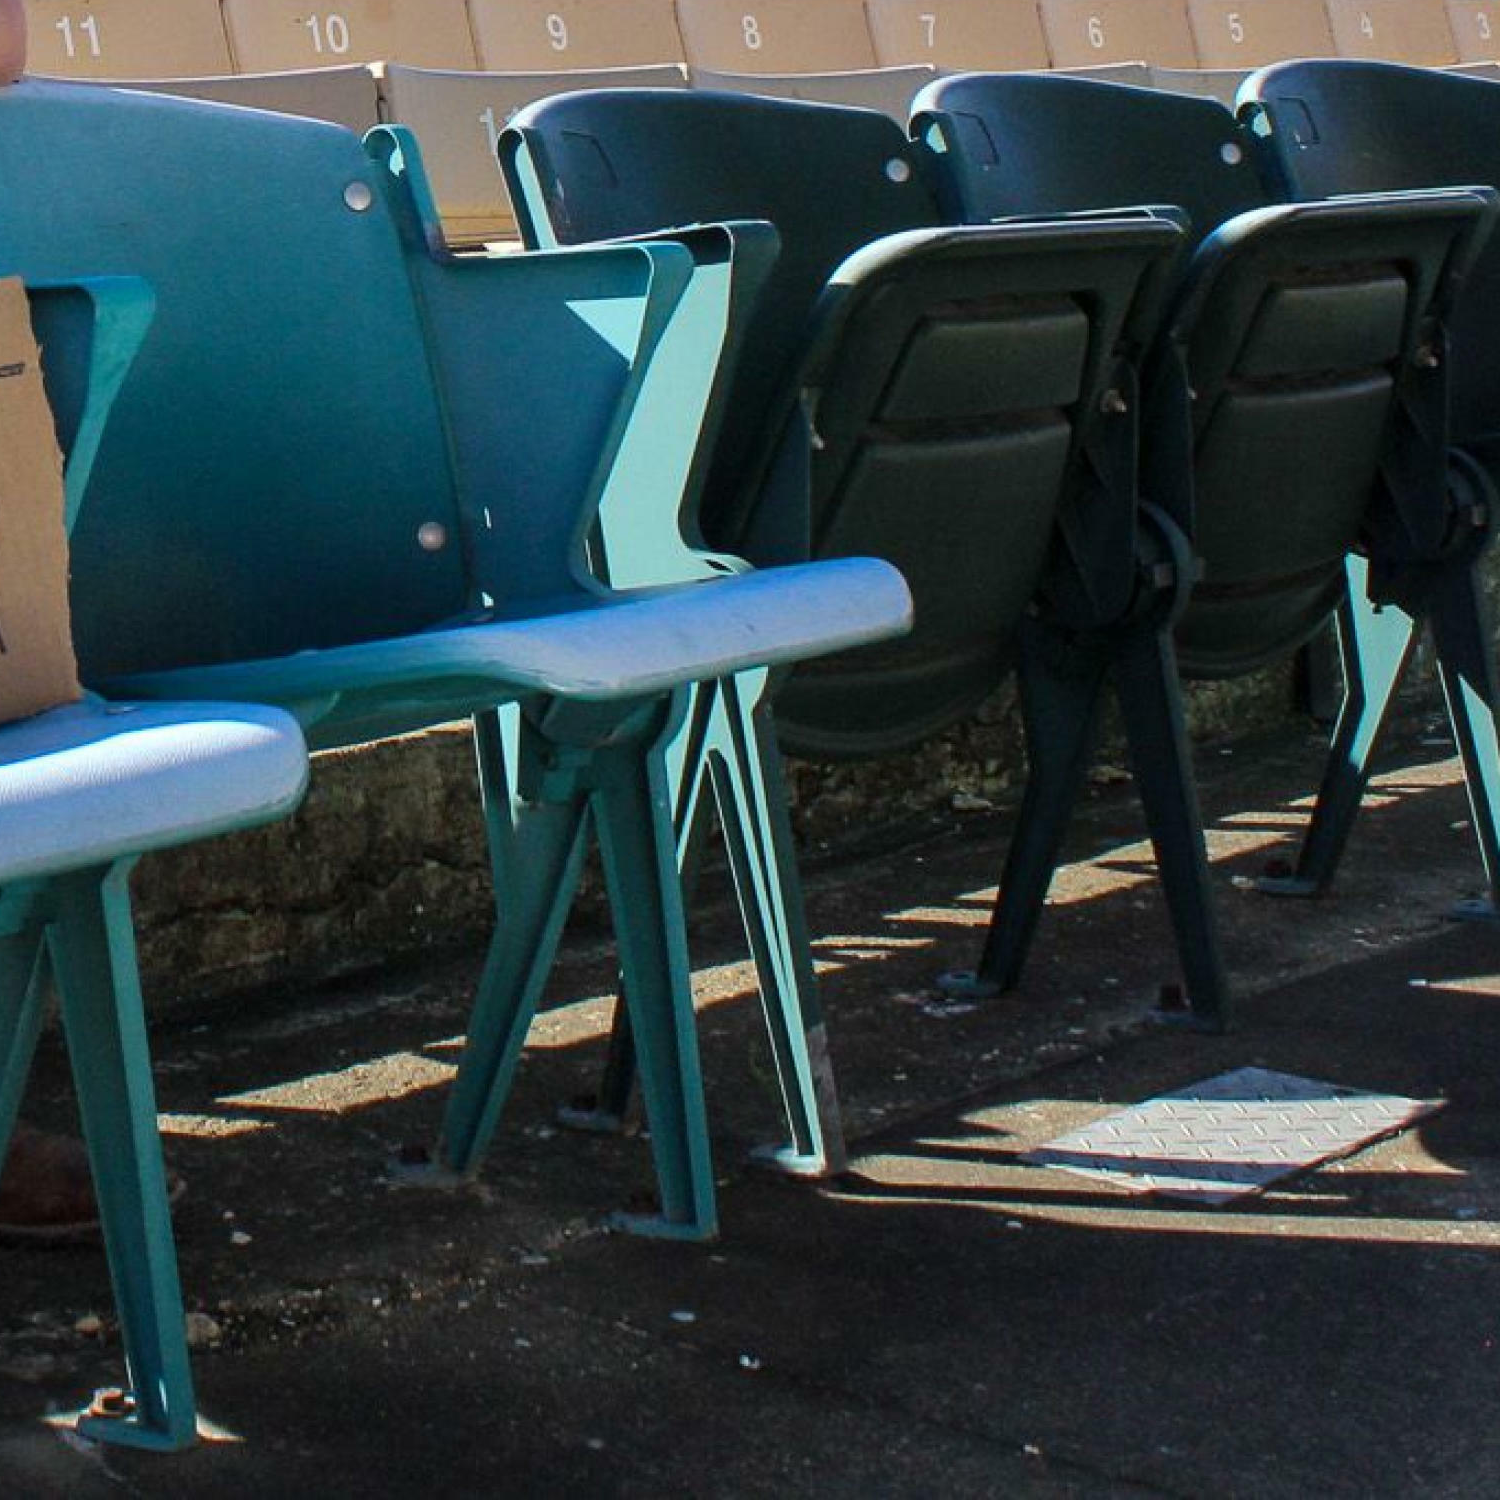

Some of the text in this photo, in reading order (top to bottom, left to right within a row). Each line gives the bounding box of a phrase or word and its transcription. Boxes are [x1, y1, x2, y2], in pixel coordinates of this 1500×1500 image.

[54, 13, 102, 58] 11
[305, 13, 350, 55] 10
[545, 12, 570, 52] 9
[741, 12, 762, 51] 8
[917, 12, 937, 49] 7
[1086, 15, 1105, 49] 6
[1227, 12, 1245, 45] 5
[1357, 10, 1375, 41] 4
[1475, 10, 1492, 41] 3
